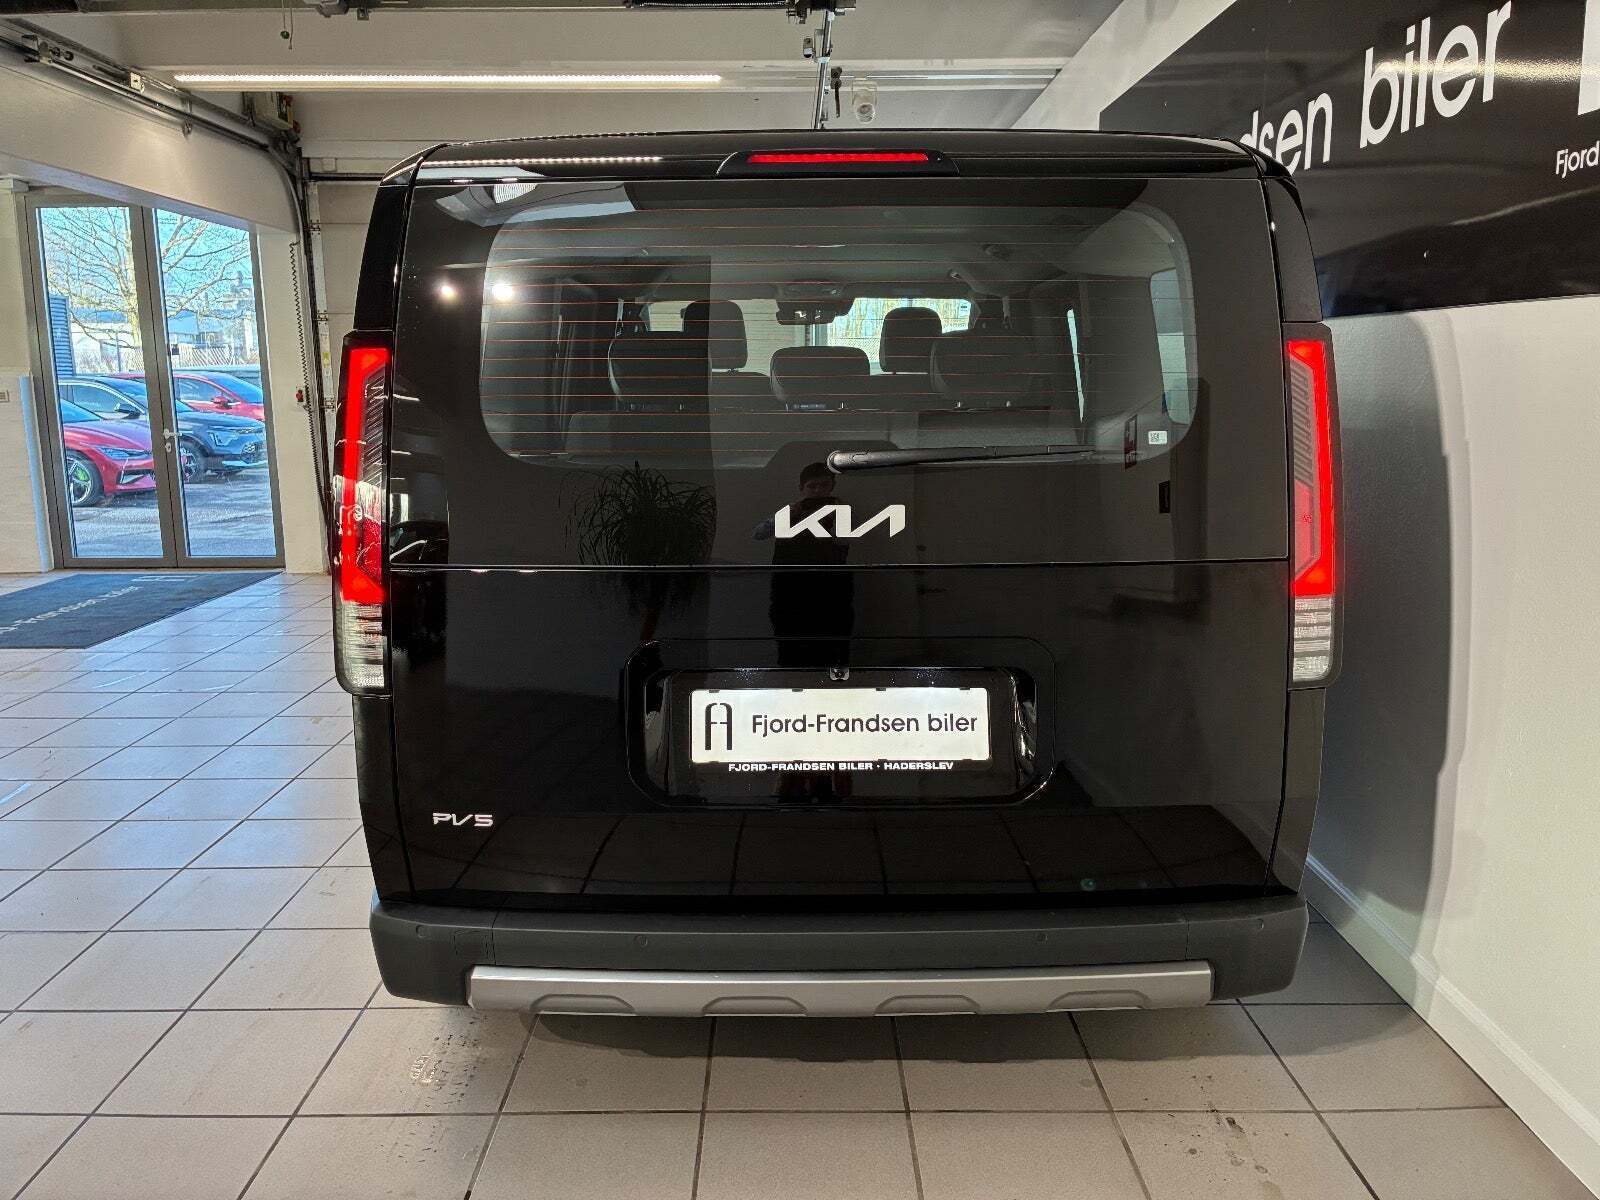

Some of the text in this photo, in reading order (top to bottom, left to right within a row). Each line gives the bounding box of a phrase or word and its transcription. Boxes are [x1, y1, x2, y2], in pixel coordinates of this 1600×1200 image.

[1359, 0, 1512, 149] biler
[1555, 140, 1600, 179] Fjord
[774, 504, 906, 538] KIA
[752, 713, 978, 738] Fjord-Frandsen biler
[728, 761, 954, 772] FJORD-FRANDSEN BILER HADERSLEV
[432, 812, 494, 827] PV5
